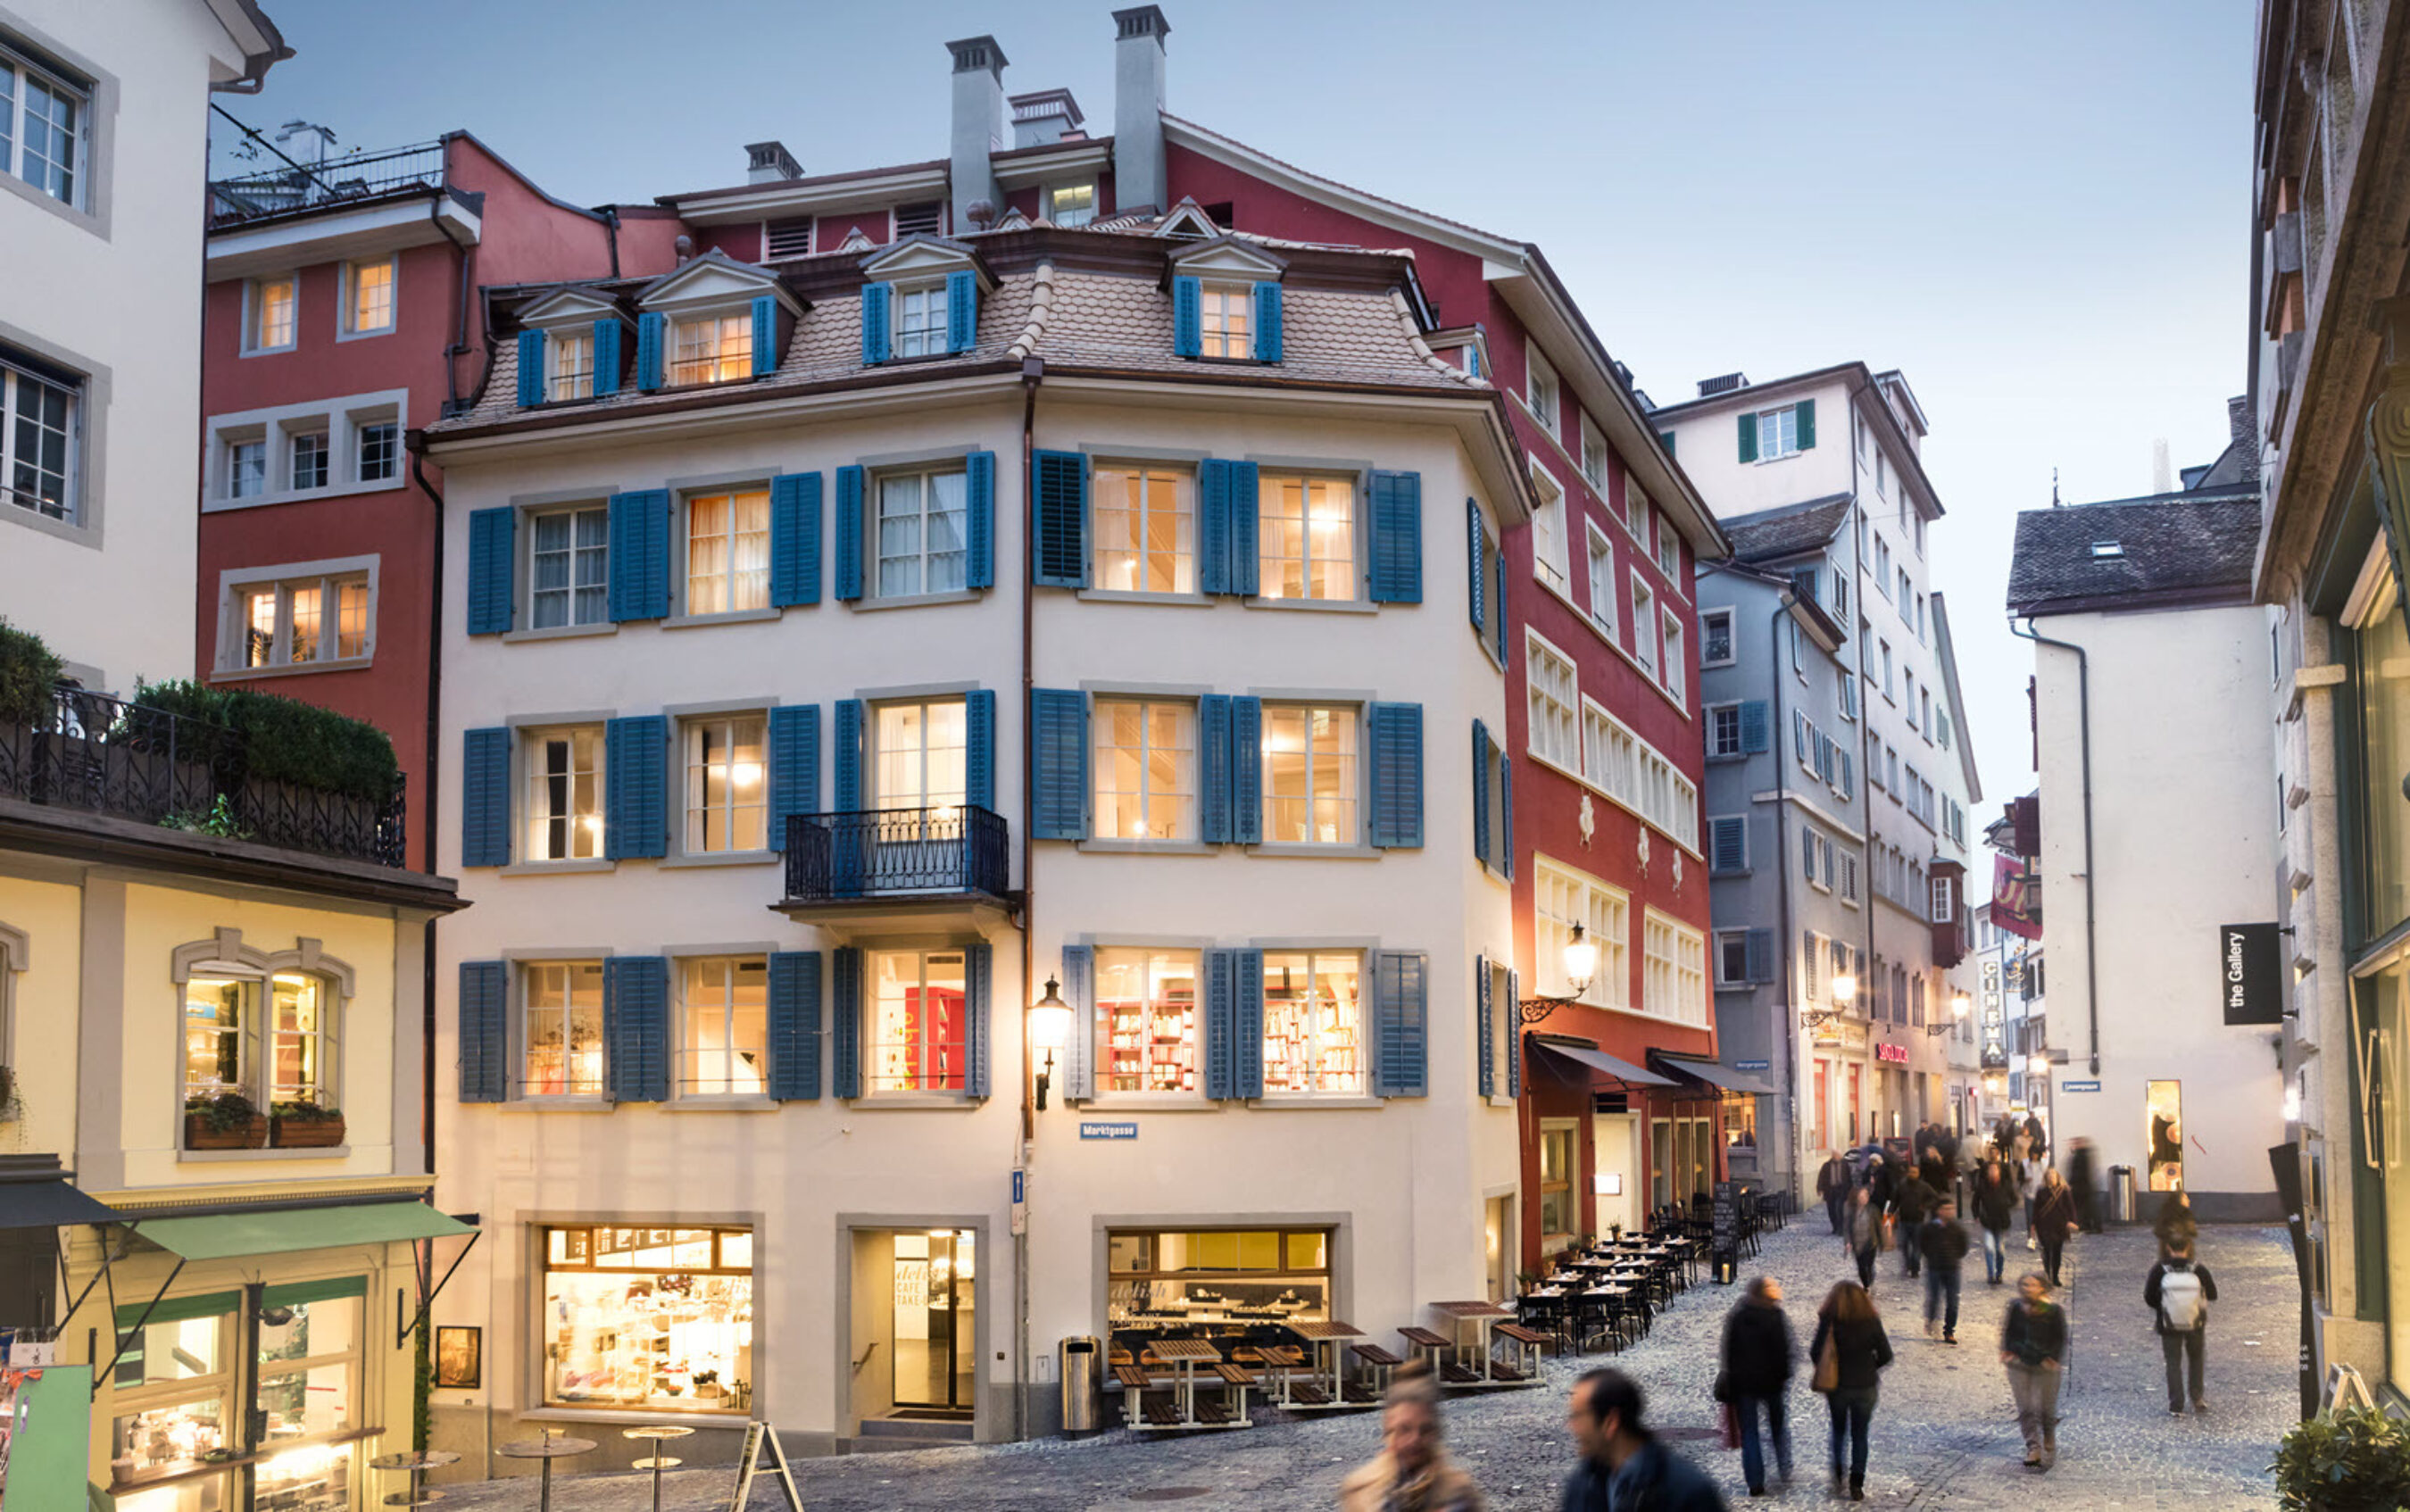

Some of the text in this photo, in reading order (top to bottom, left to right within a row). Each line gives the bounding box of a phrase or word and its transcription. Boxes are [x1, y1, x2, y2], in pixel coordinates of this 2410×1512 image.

[2227, 932, 2245, 1008] the Gallery
[1984, 964, 2000, 1055] CINEMA
[1084, 1126, 1134, 1137] Marktgasse
